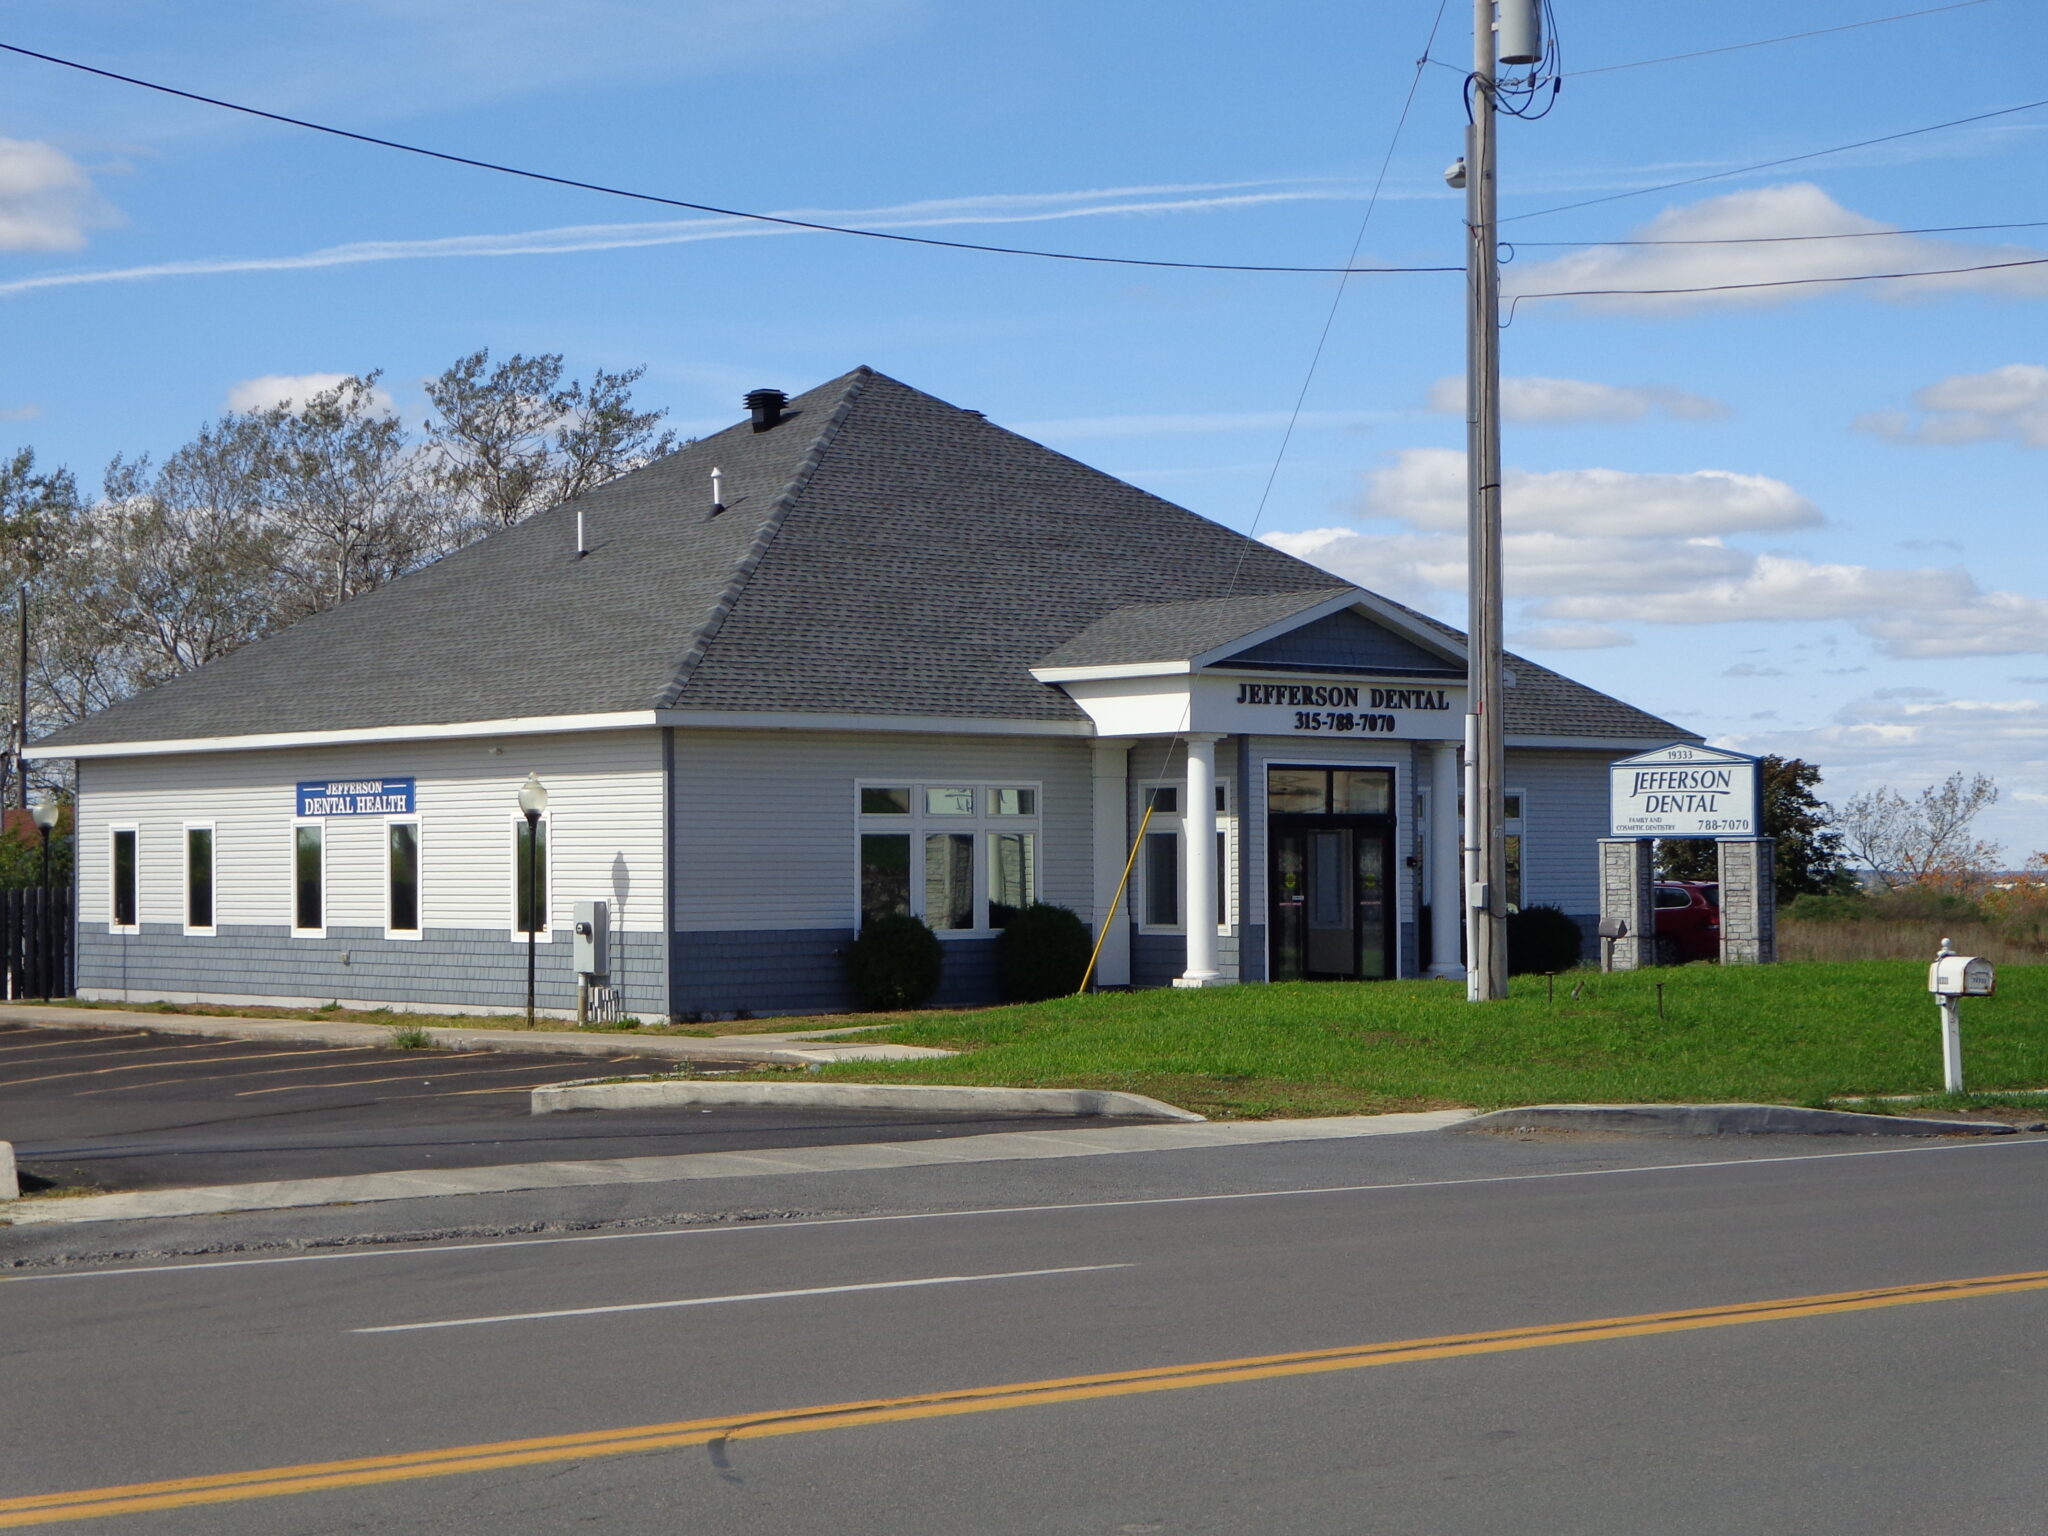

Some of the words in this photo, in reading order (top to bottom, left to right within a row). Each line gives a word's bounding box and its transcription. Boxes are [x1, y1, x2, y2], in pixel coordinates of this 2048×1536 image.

[1237, 683, 1359, 707] JEFFERSON
[1370, 688, 1450, 710] DENTAL
[1294, 711, 1396, 732] 315-788-7070
[1668, 751, 1693, 759] 19333
[326, 781, 383, 795] JEFFERSON
[1629, 770, 1732, 797] JEFFERSON
[304, 797, 354, 815] DENTAL
[356, 795, 407, 813] HEALTH
[1645, 795, 1718, 813] DENTAL
[1698, 819, 1749, 830] 788-7070
